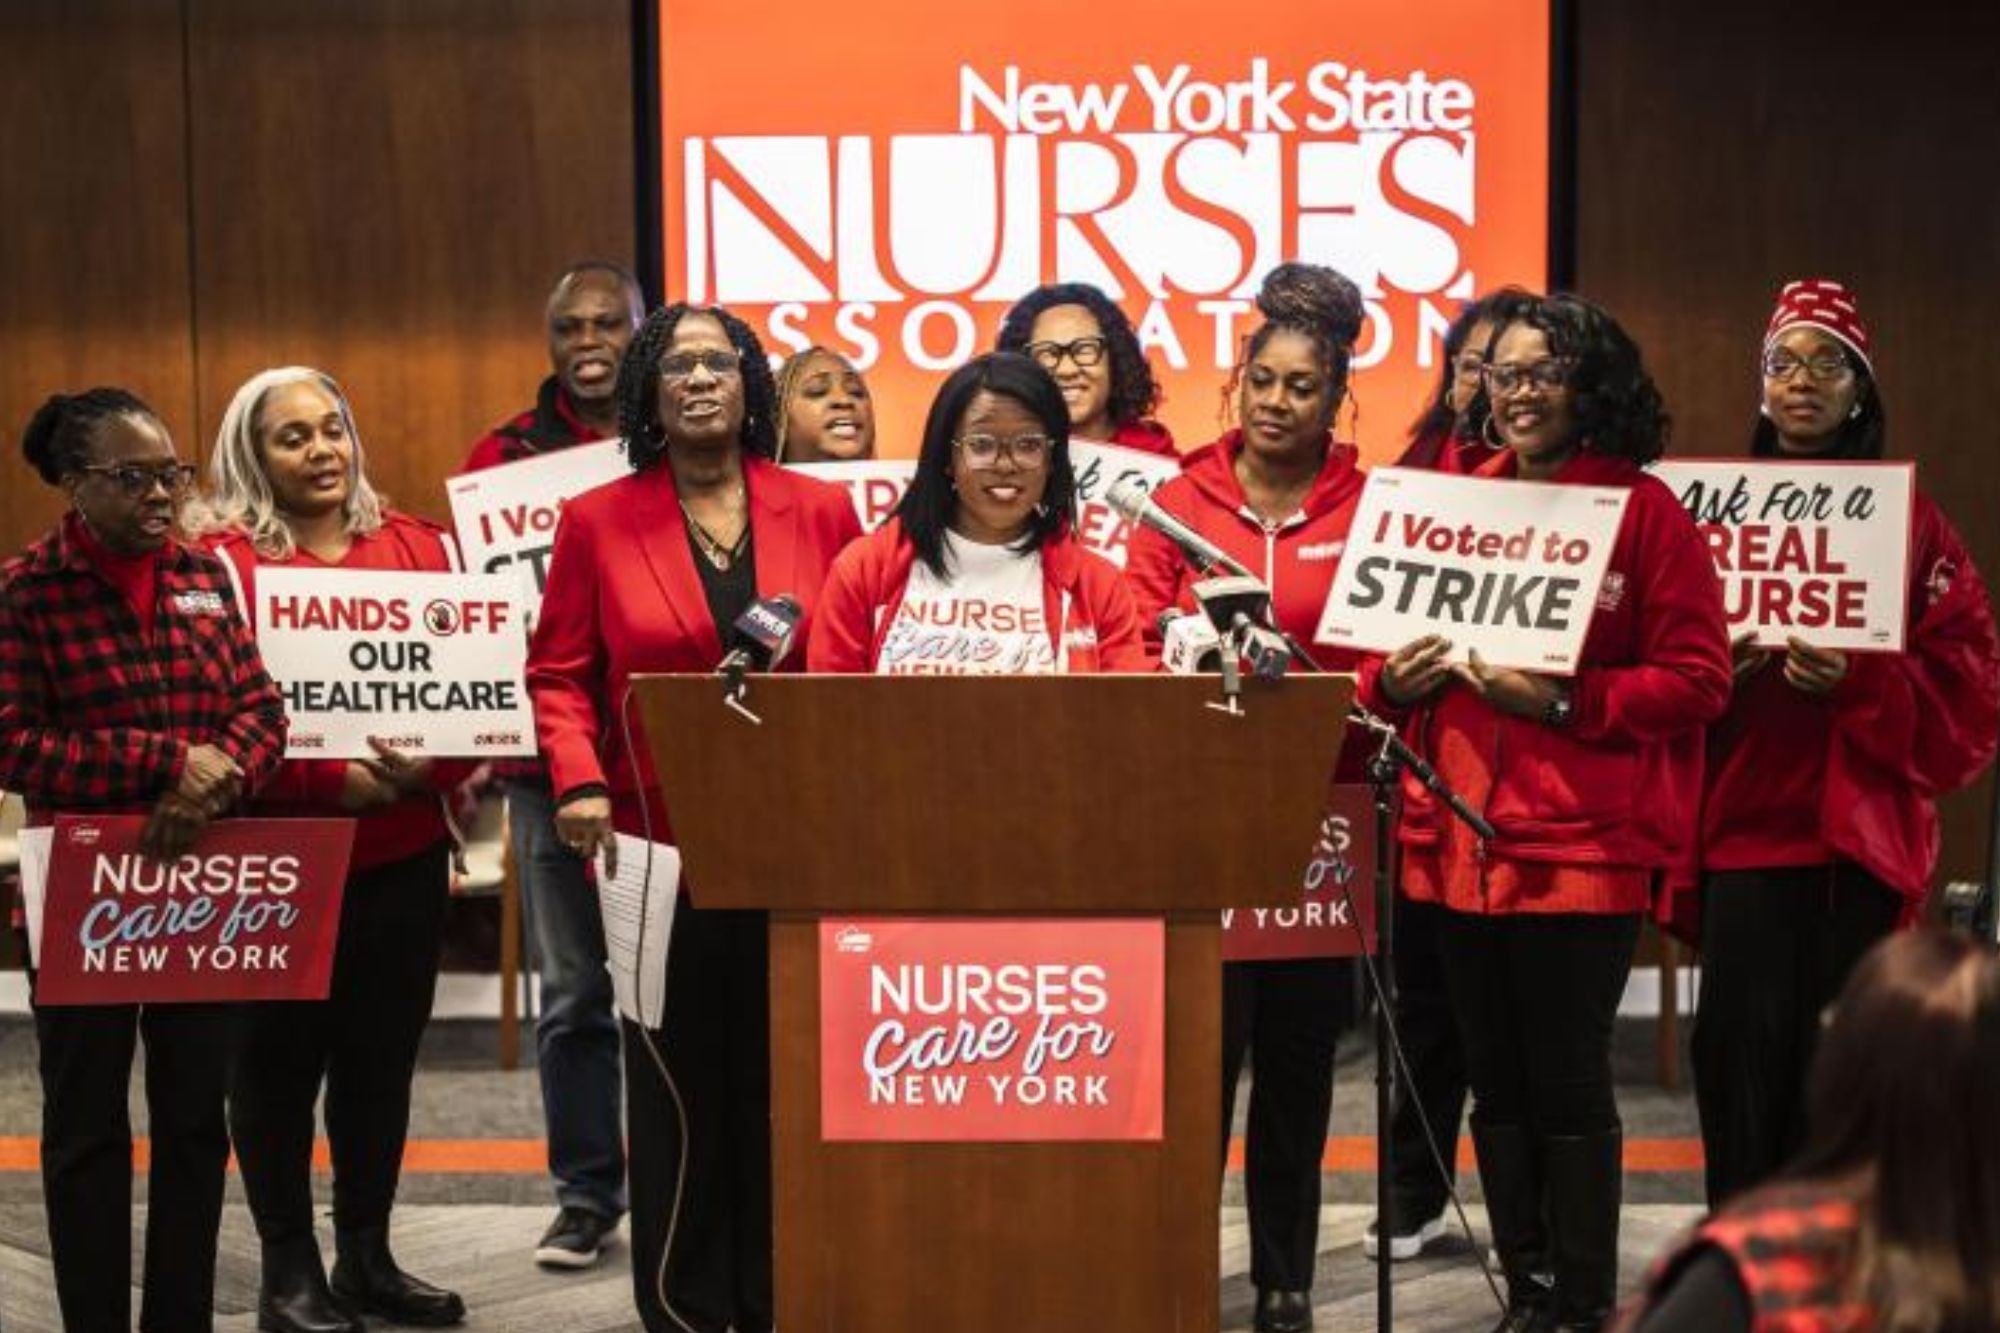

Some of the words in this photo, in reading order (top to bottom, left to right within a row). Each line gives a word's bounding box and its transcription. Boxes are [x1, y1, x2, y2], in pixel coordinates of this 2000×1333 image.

[960, 65, 1131, 133] New
[1133, 58, 1294, 133] York
[1306, 62, 1474, 133] State
[683, 132, 1474, 302] NURSES
[1680, 474, 1750, 525] Ask
[1759, 481, 1834, 522] For
[1843, 484, 1875, 521] a
[480, 513, 494, 545] I
[1374, 511, 1391, 543] I
[1402, 513, 1535, 560] Voted
[1542, 531, 1590, 565] to
[1697, 525, 1846, 573] REAL
[269, 595, 411, 632] HANDS
[1348, 555, 1580, 631] STRIKE
[1721, 579, 1867, 628] URSE
[901, 599, 1041, 633] NURSE
[349, 640, 432, 672] OUR
[277, 681, 518, 712] HEALTHCARE
[93, 854, 300, 894] NURSES
[1303, 858, 1355, 889] or
[80, 896, 218, 950] Care
[219, 892, 300, 944] for
[1254, 901, 1348, 928] YORK
[82, 945, 168, 972] NEW
[187, 945, 290, 971] YORK
[870, 965, 1107, 1015] NURSES
[863, 1015, 1018, 1080] Care
[1023, 1010, 1114, 1075] for
[868, 1075, 966, 1105] NEW
[988, 1075, 1109, 1105] YORK
